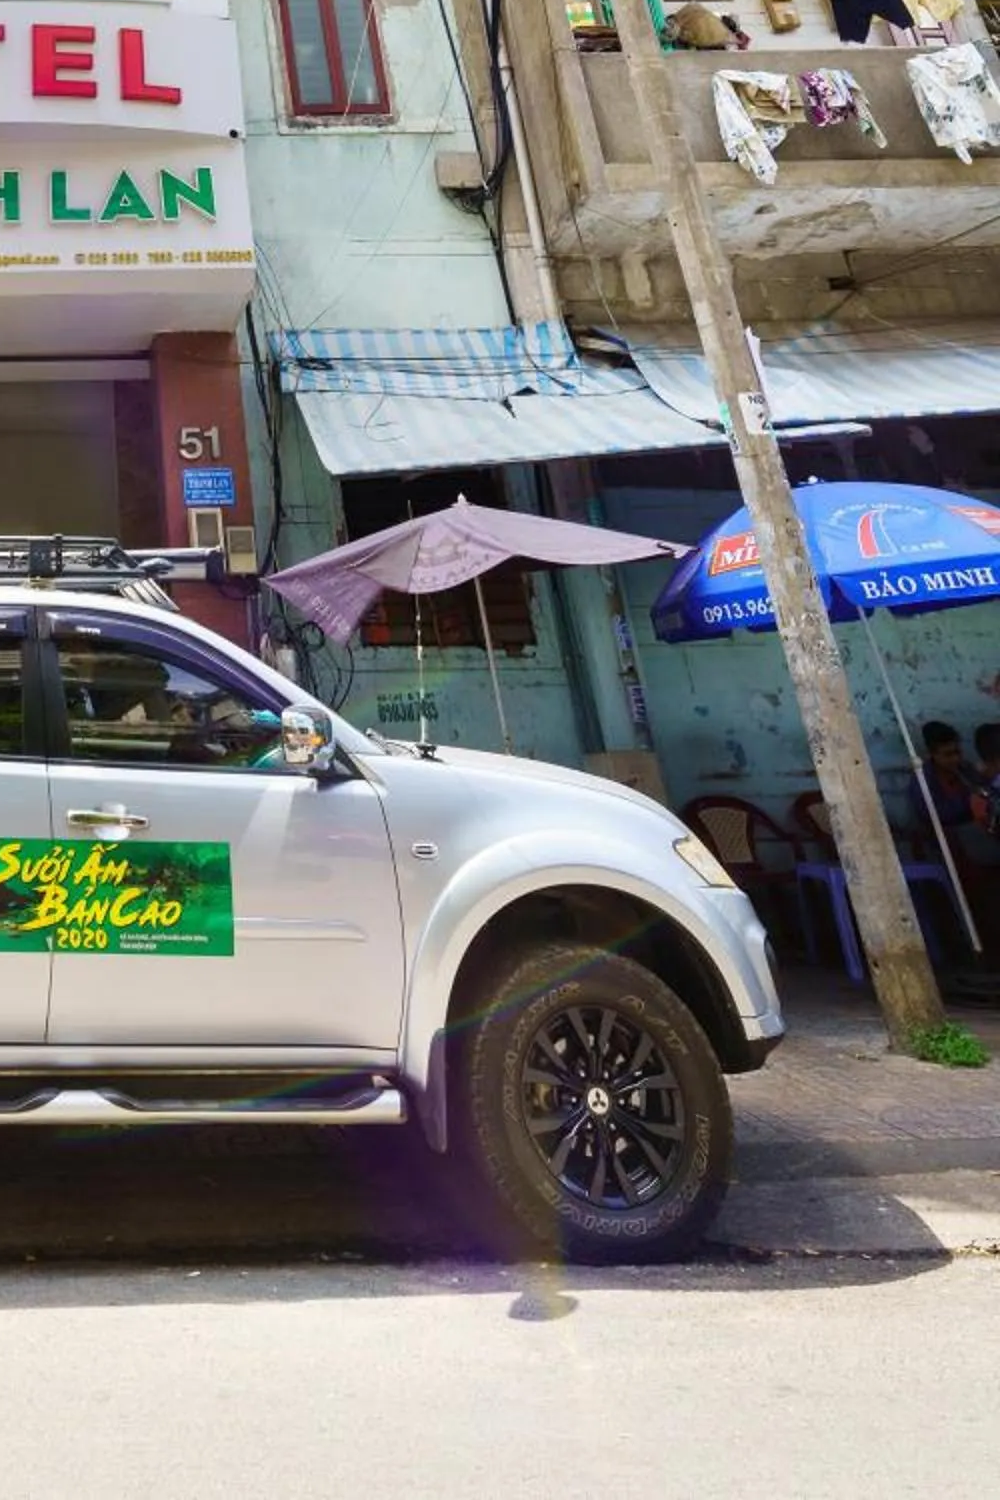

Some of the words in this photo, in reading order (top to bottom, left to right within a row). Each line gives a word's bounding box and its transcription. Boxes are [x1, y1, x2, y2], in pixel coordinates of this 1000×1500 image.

[50, 166, 218, 225] LAN
[179, 426, 220, 460] 51
[860, 571, 917, 599] BẢO
[922, 567, 997, 591] MINH
[57, 927, 108, 949] 2020
